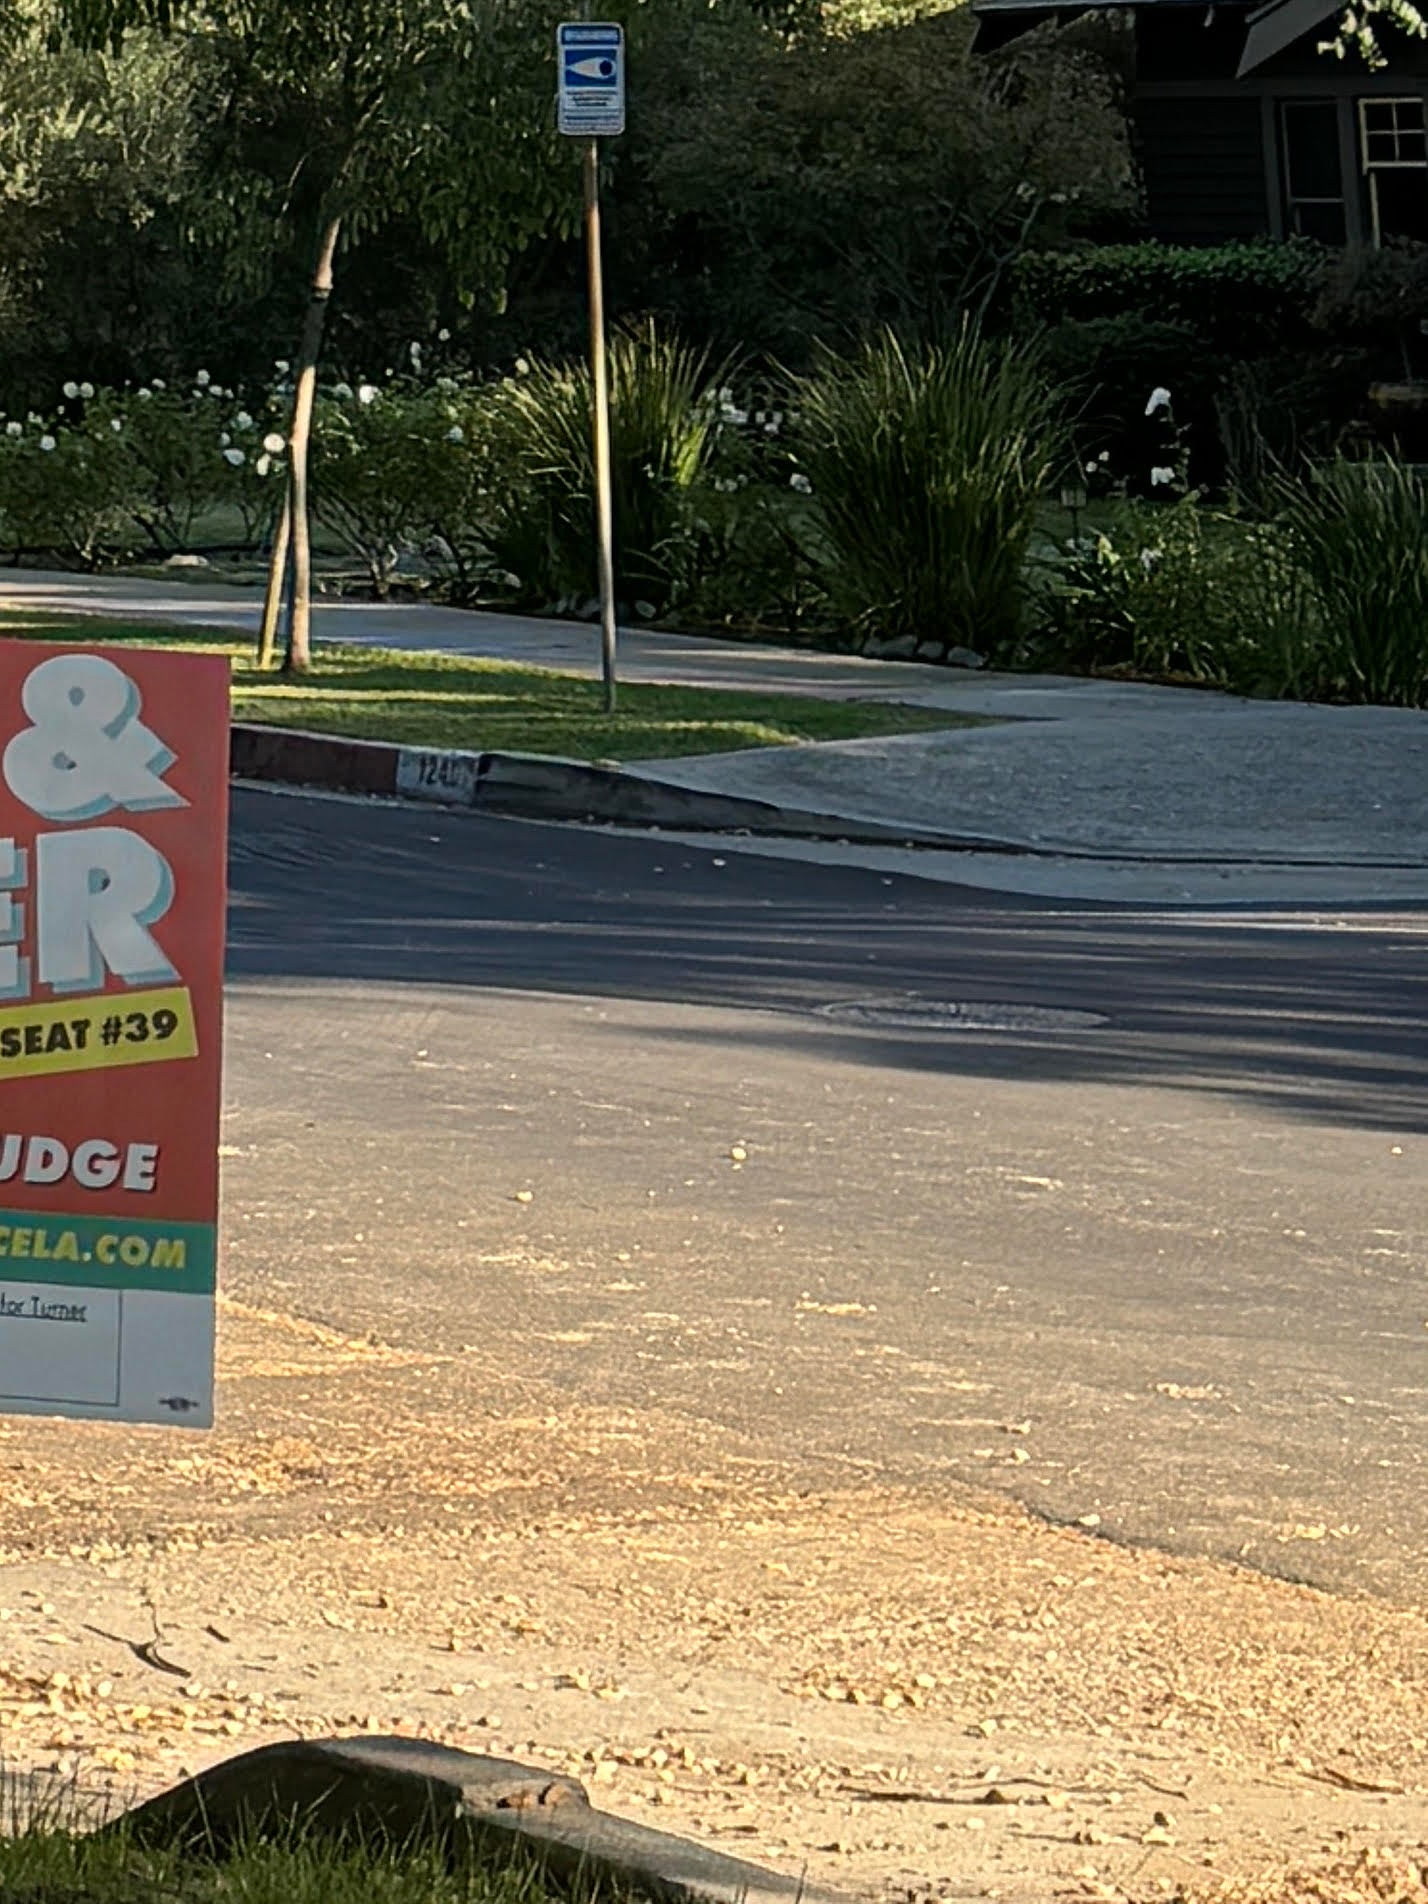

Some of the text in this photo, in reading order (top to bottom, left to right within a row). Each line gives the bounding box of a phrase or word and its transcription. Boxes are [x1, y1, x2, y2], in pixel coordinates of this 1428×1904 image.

[2, 653, 192, 823] &
[0, 1008, 179, 1058] SEAT #39
[0, 1292, 25, 1315] for
[31, 1295, 87, 1322] Turner
